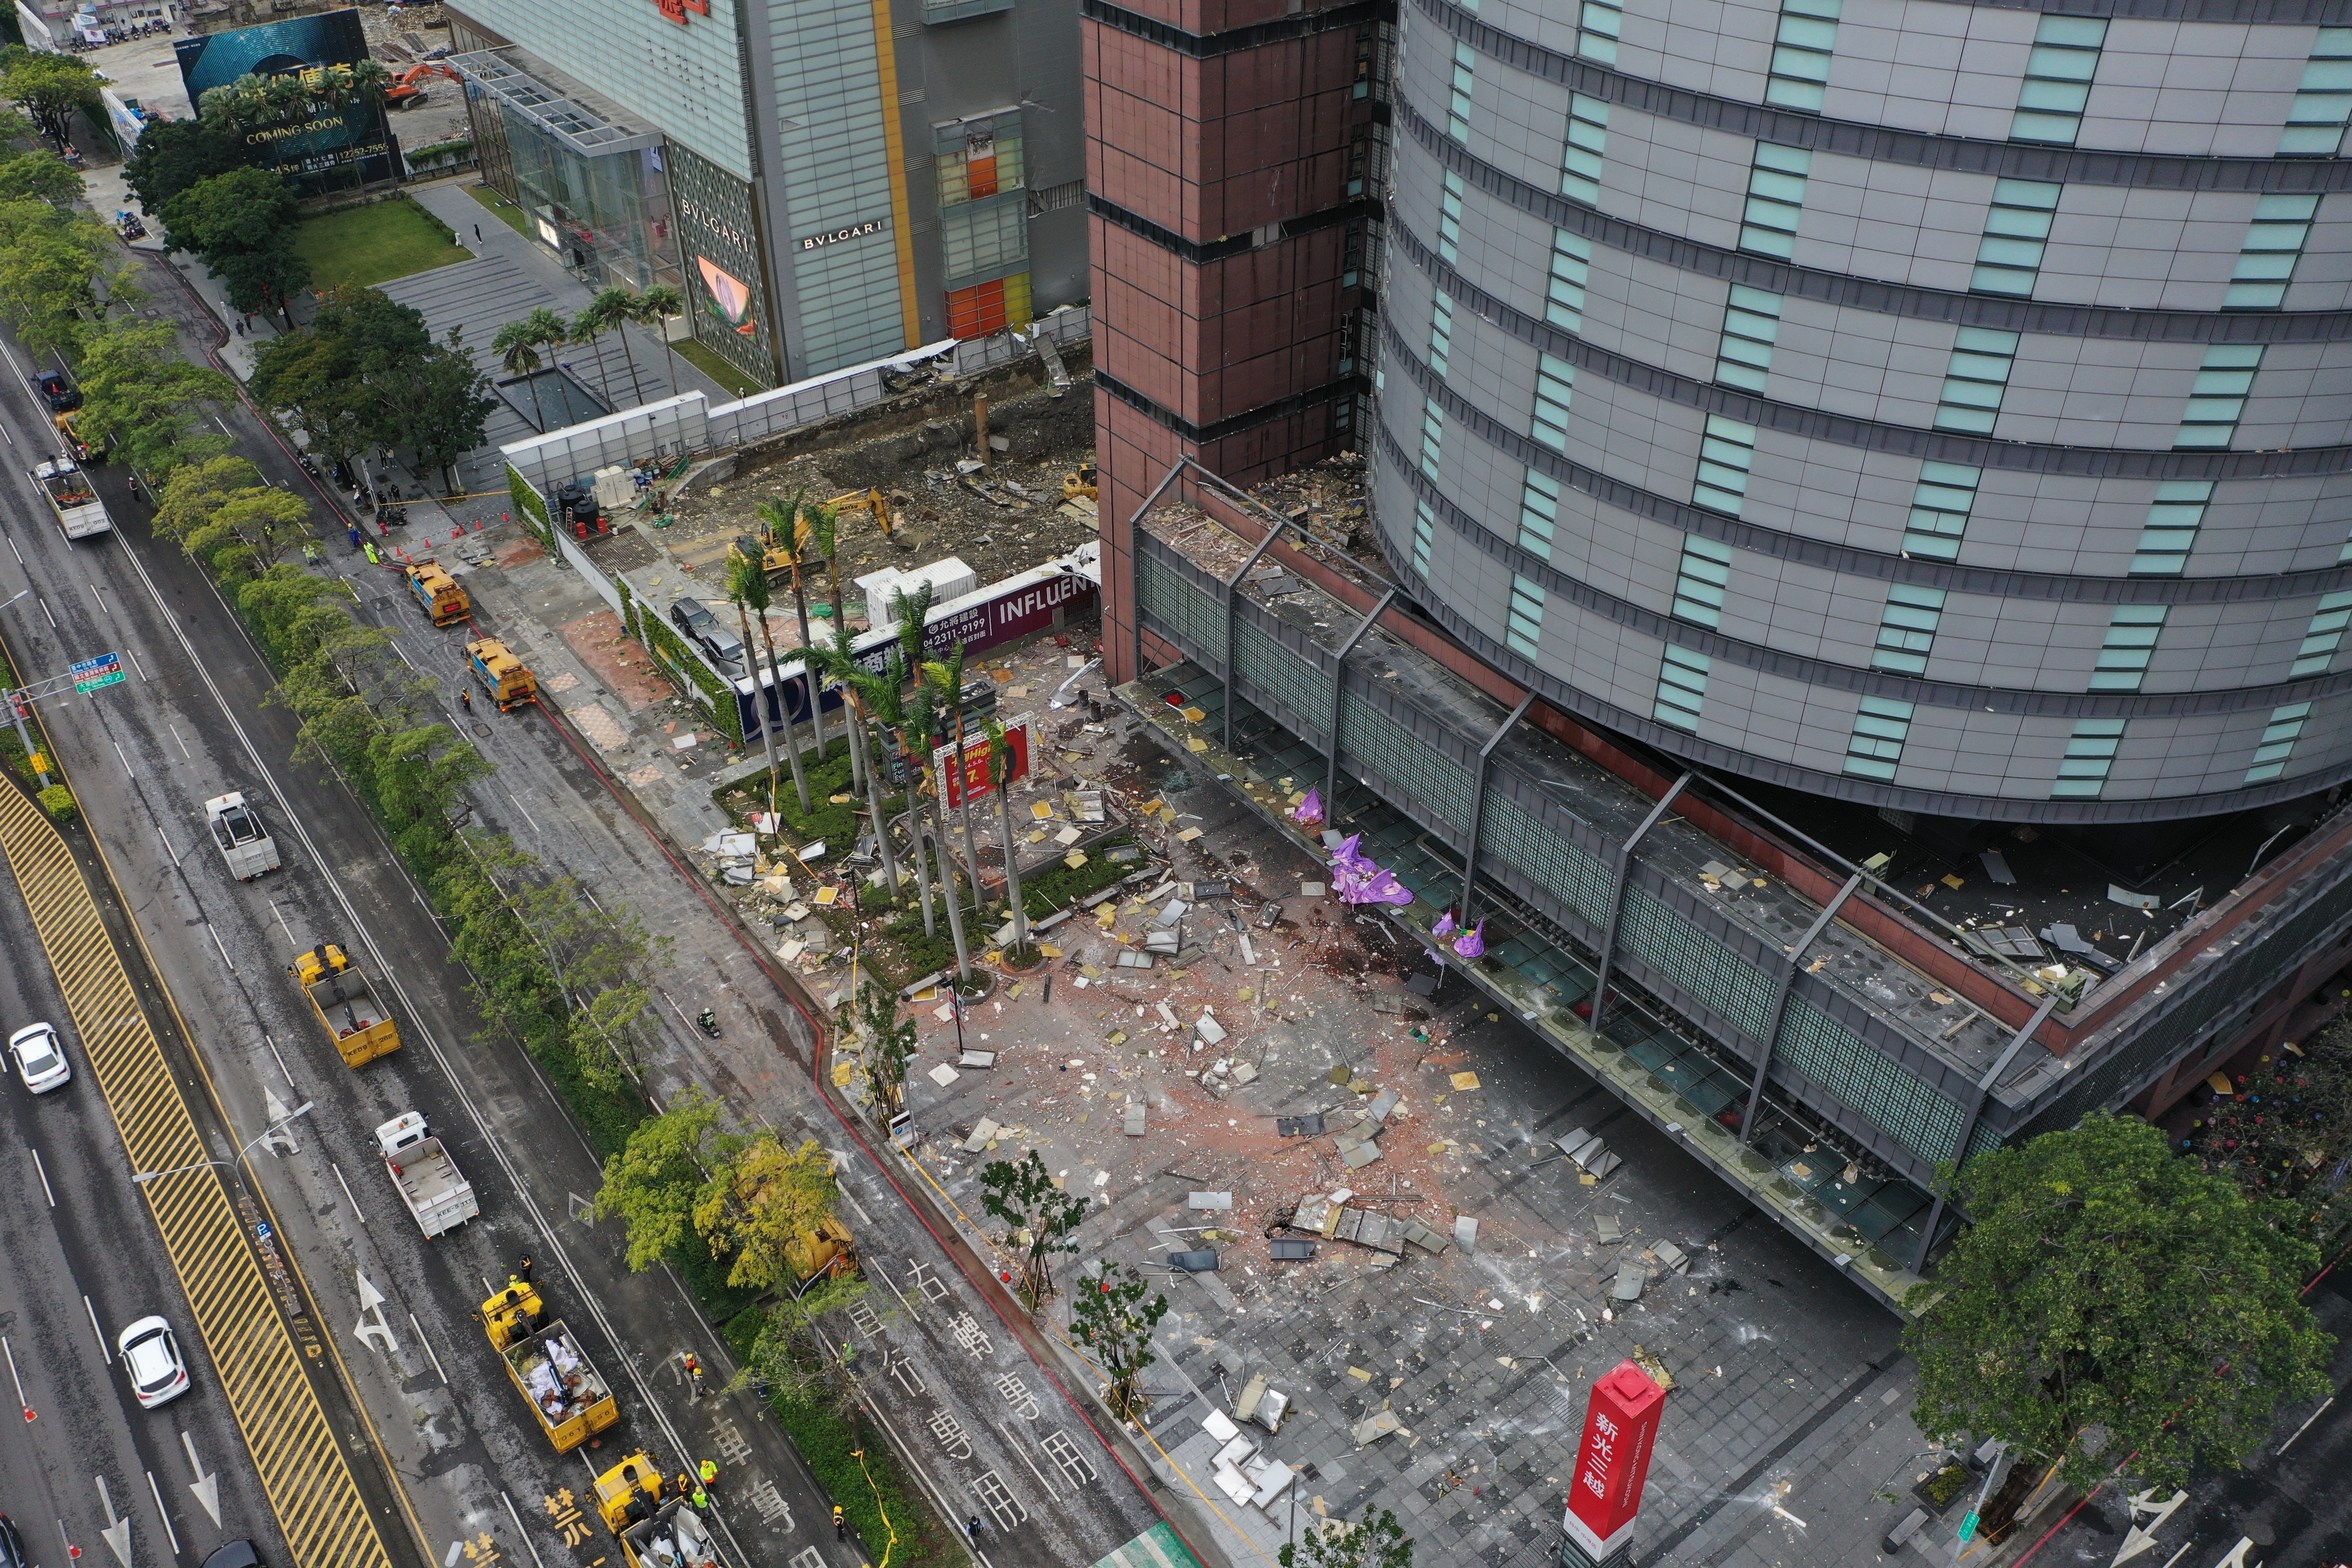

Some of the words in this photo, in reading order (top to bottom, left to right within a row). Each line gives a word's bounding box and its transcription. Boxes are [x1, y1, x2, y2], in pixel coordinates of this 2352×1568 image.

[247, 125, 301, 145] COMING
[304, 116, 343, 134] SOON
[682, 199, 748, 252] BVLGARI
[804, 221, 881, 249] BVLGARI
[934, 618, 985, 645] 2311-9199
[940, 608, 978, 631] 允將建設
[1638, 1421, 1647, 1441] SHIN
[1583, 1412, 1618, 1499] 新光三越
[1633, 1440, 1642, 1463] KONG
[1622, 1462, 1637, 1508] MITSUKOSHI
